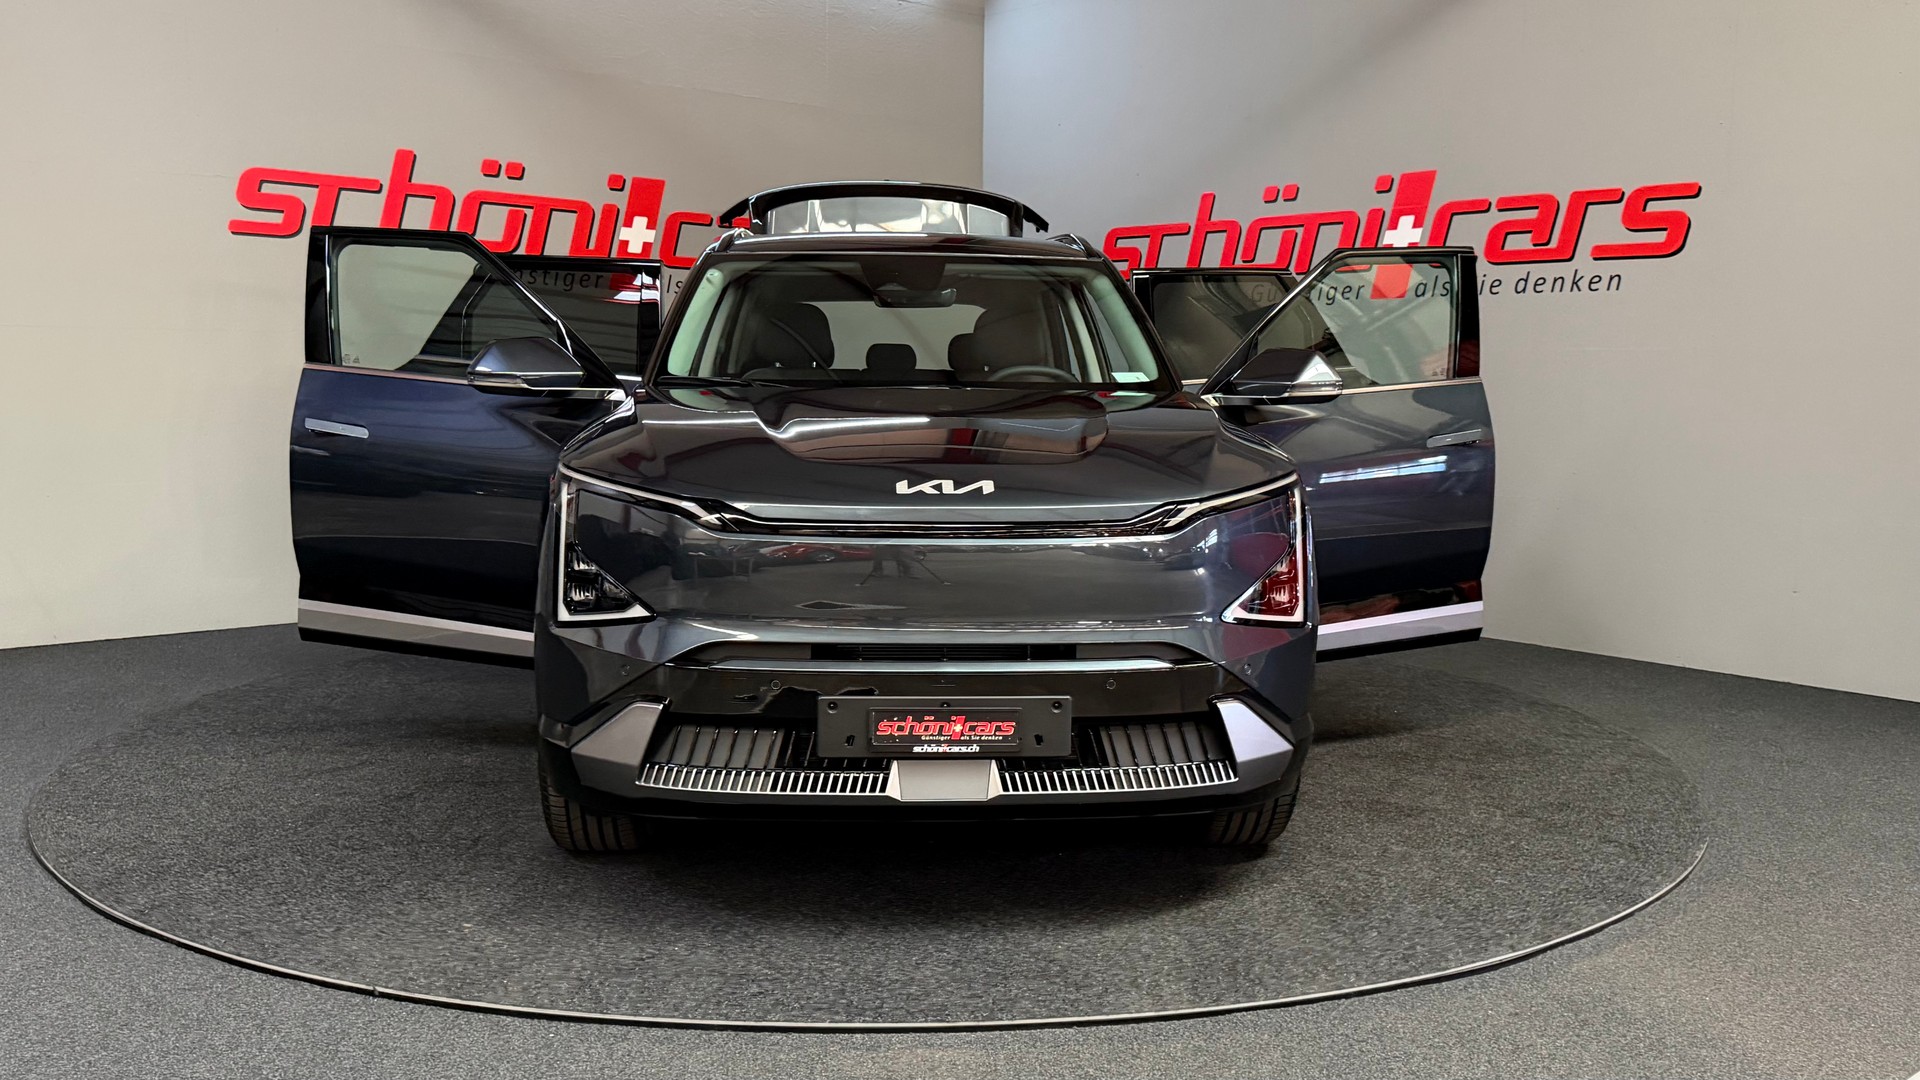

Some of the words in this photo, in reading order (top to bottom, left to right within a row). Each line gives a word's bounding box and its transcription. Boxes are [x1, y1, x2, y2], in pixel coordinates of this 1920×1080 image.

[1414, 275, 1450, 298] als
[1479, 274, 1502, 296] ie
[1514, 269, 1622, 295] denken
[896, 479, 995, 495] KIA
